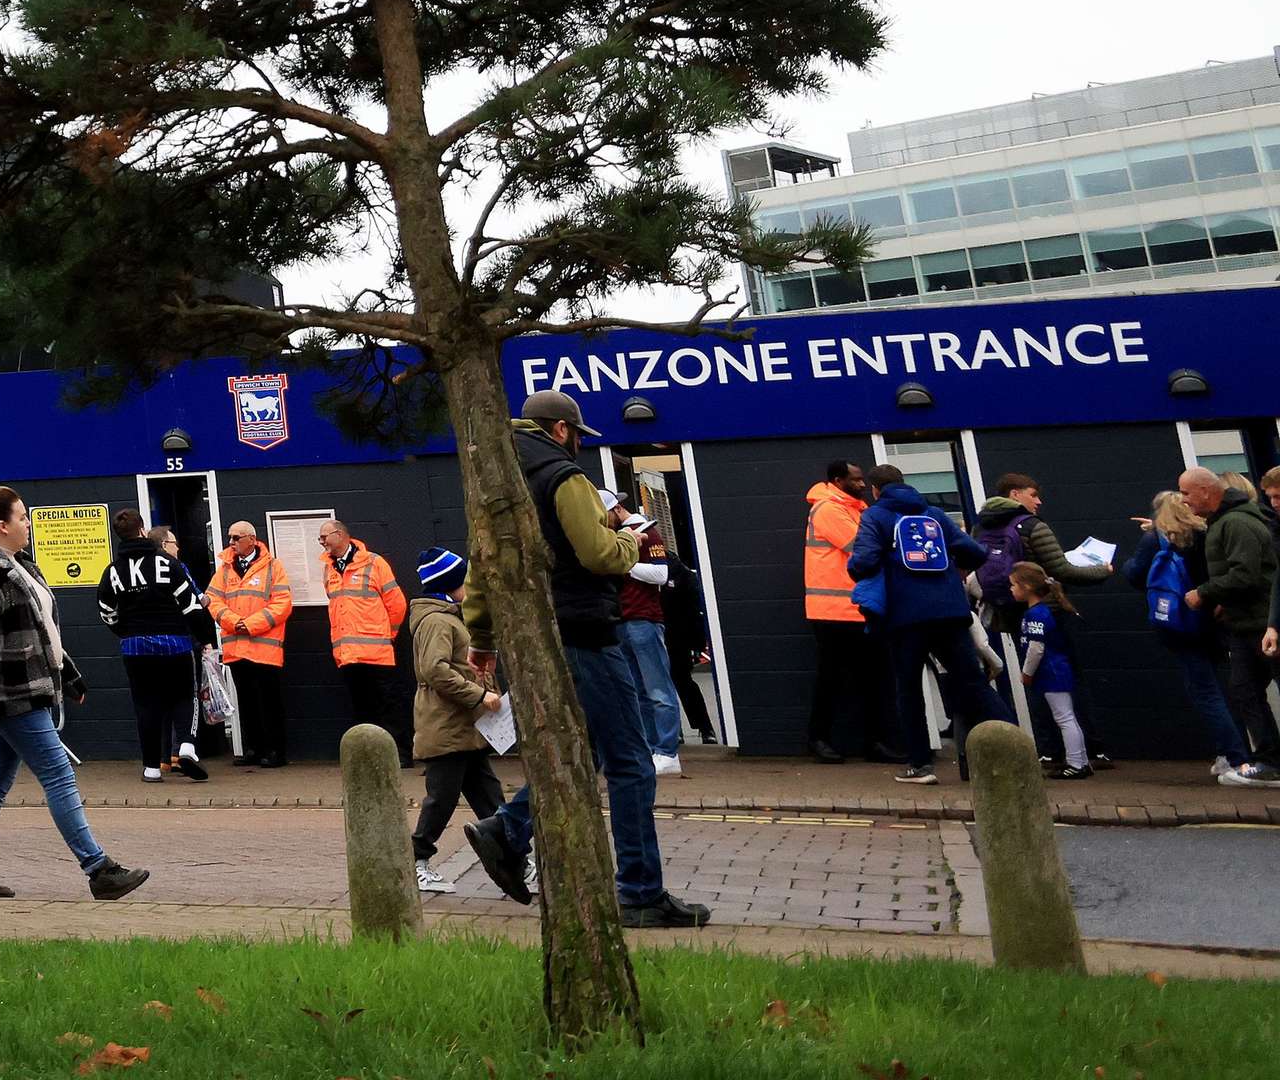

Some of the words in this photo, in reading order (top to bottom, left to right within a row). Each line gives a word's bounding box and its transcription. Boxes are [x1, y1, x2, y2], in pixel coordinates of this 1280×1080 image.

[523, 341, 793, 395] FANZONE
[808, 322, 1149, 378] ENTRANCE
[166, 457, 184, 471] 55
[37, 511, 69, 520] SPECIAL
[73, 509, 101, 518] NOTICE
